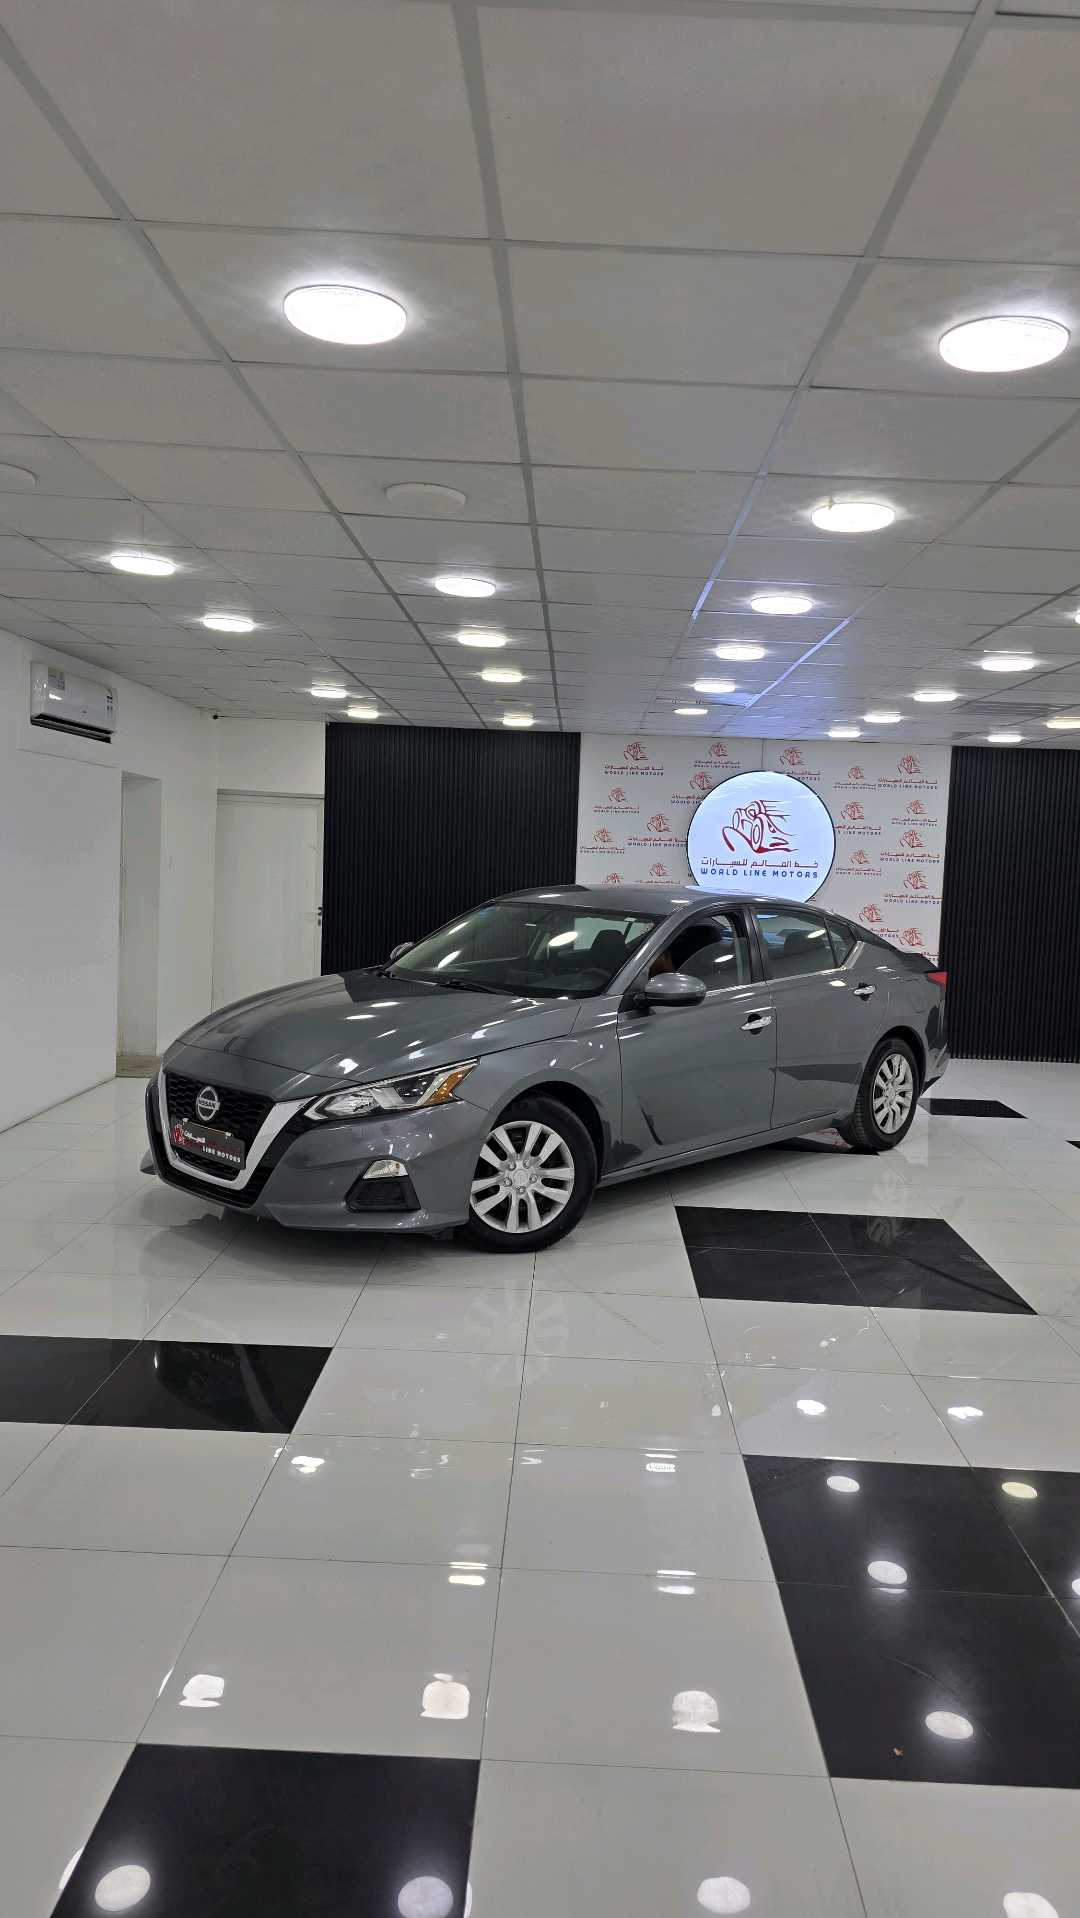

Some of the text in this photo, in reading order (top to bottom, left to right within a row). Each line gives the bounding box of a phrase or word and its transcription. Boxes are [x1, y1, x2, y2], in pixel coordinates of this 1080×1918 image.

[701, 856, 819, 869] خط العالم للسيارات
[700, 867, 738, 876] WORLD
[743, 869, 767, 877] LINE
[772, 869, 819, 879] MOTORS
[216, 1150, 241, 1163] MOTORS
